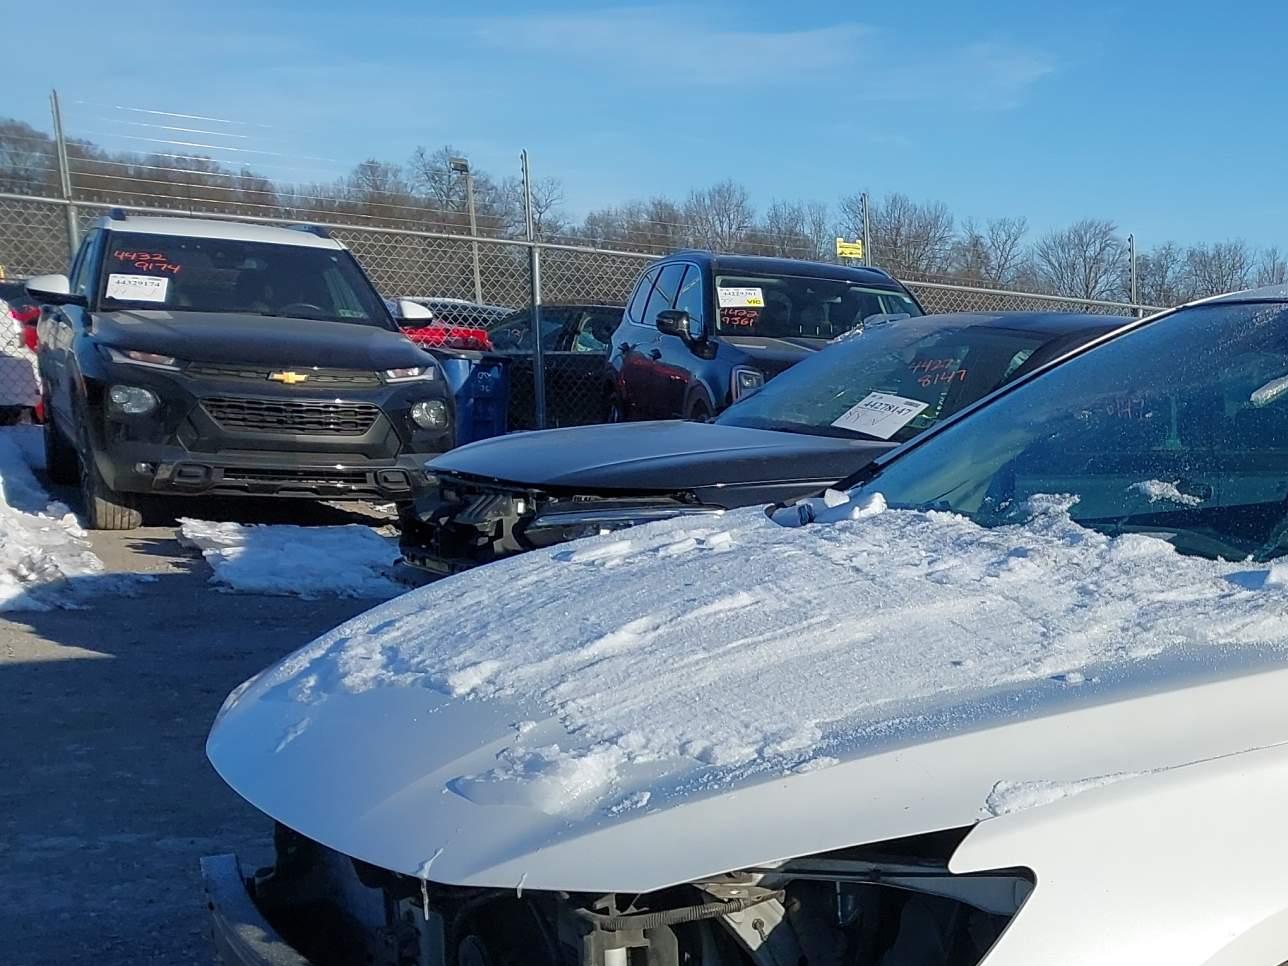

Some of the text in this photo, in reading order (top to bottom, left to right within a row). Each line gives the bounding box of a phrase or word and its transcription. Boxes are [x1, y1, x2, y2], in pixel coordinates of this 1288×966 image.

[113, 250, 167, 261] 4432
[134, 261, 181, 273] 9174
[112, 279, 161, 287] 44329174
[917, 369, 967, 387] 8147
[863, 400, 912, 417] 44278147
